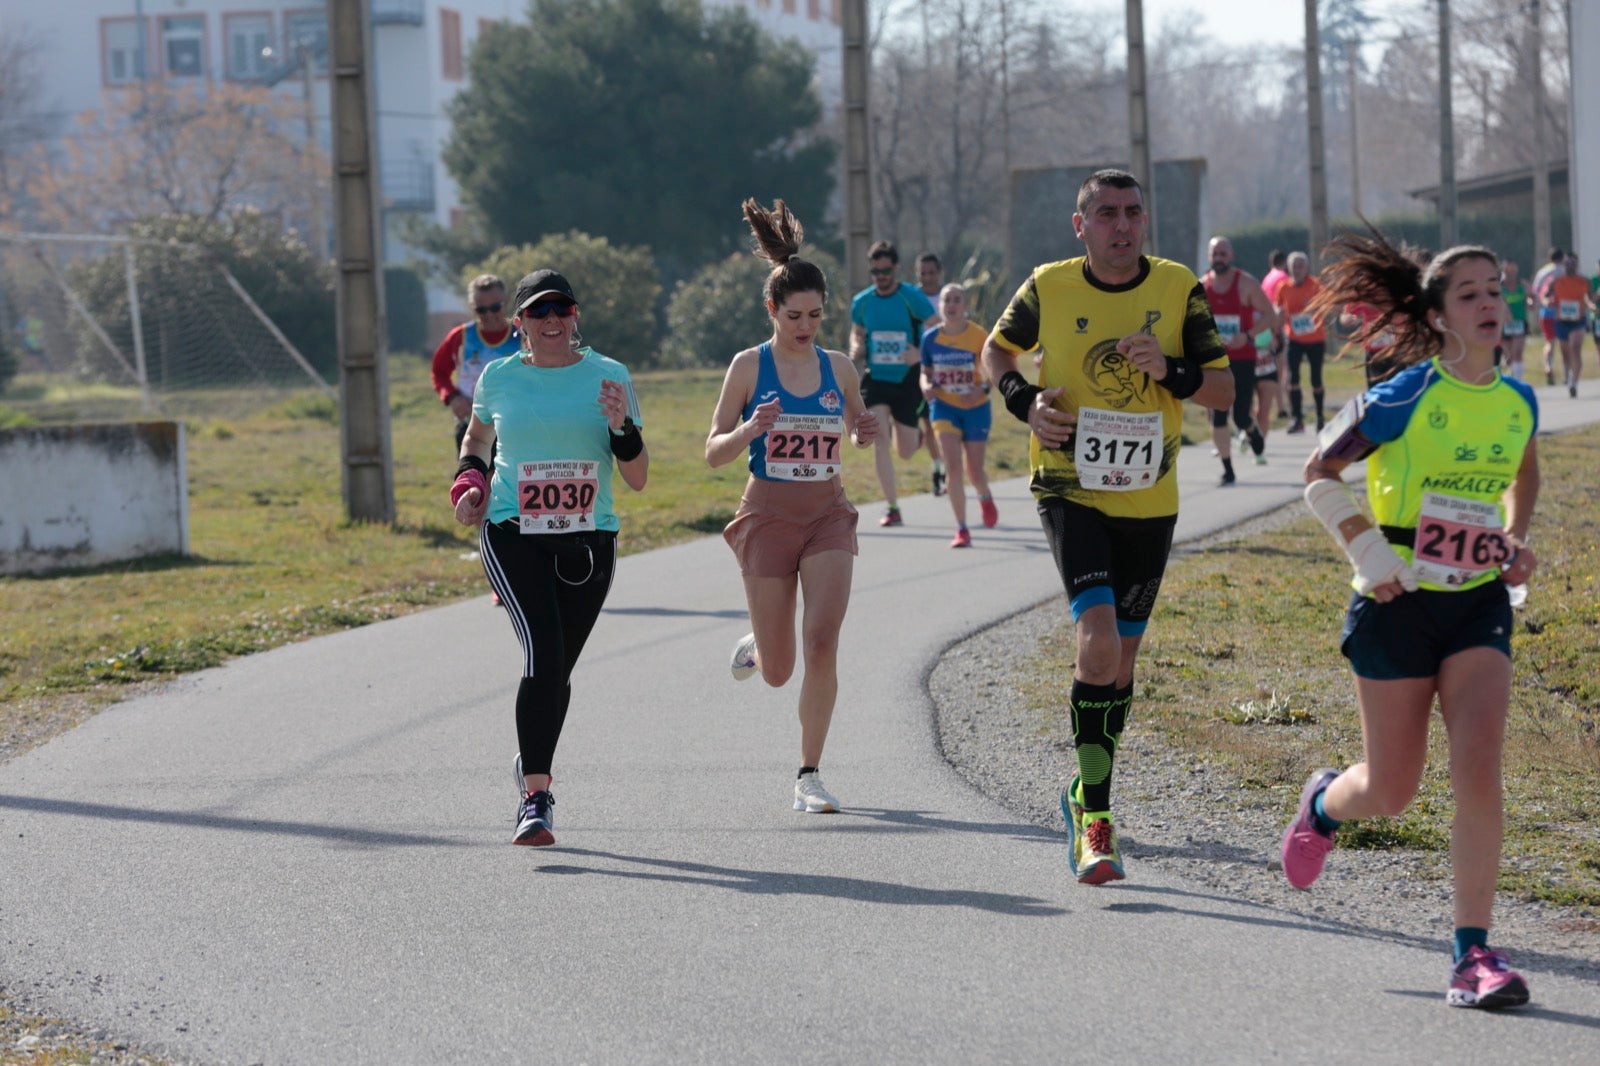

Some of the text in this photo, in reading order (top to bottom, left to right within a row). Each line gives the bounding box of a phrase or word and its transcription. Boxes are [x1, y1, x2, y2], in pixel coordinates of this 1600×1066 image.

[877, 341, 900, 353] 200
[938, 371, 973, 384] 2128
[771, 434, 839, 459] 2217
[1084, 437, 1153, 465] 3171
[538, 462, 552, 470] GRAN
[552, 462, 572, 470] PREMIO
[572, 462, 578, 470] DE
[579, 462, 594, 470] FONDO
[523, 483, 594, 510] 2030
[1422, 523, 1510, 565] 2163
